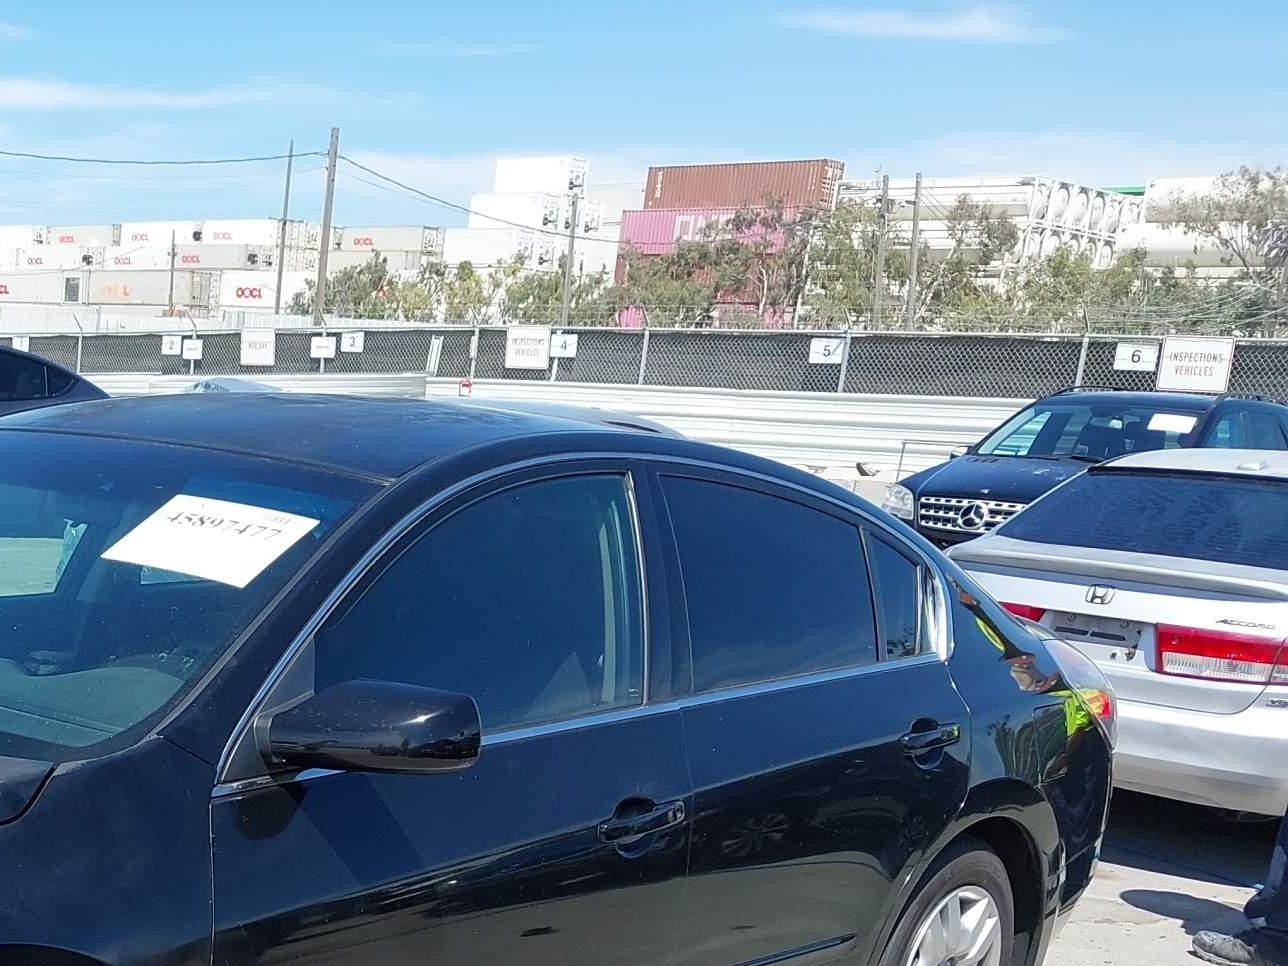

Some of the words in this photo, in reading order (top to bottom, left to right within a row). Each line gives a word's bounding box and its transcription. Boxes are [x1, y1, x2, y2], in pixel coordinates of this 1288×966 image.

[353, 237, 375, 246] OOCL
[181, 255, 201, 264] OOCL
[236, 287, 263, 299] OOCL
[560, 340, 568, 351] 4
[823, 344, 832, 357] 5
[1131, 349, 1142, 363] 6
[1169, 351, 1224, 363] INSPECTIONS
[1174, 365, 1214, 376] VEHICLES
[167, 511, 283, 540] 45897477
